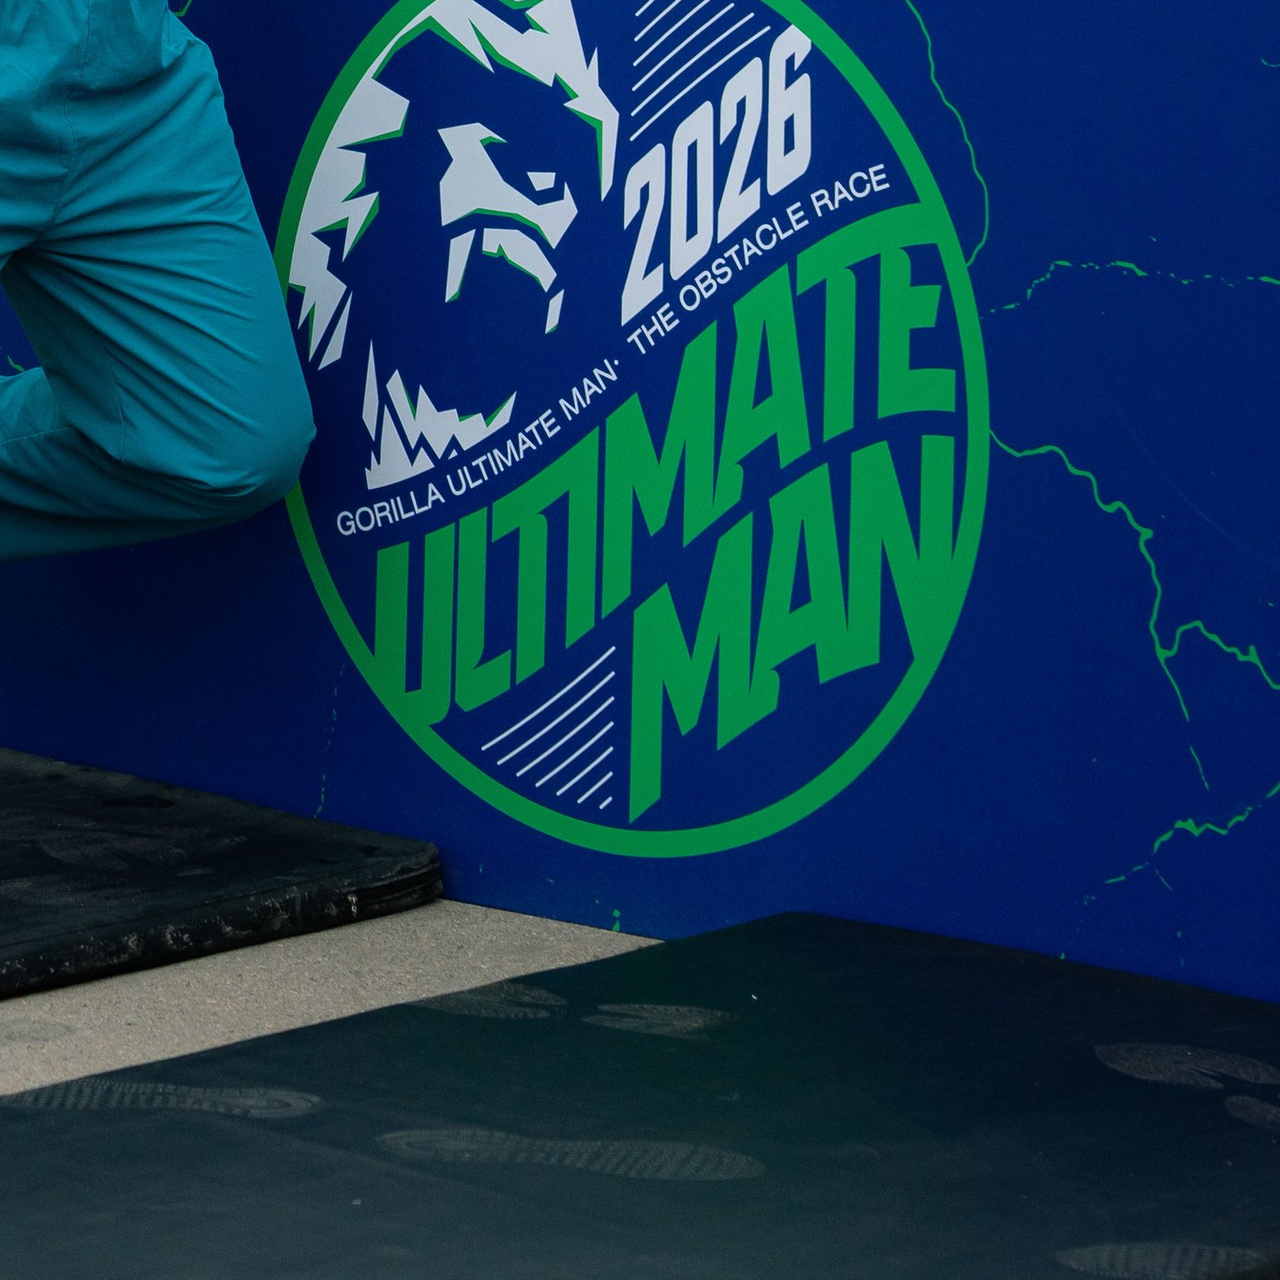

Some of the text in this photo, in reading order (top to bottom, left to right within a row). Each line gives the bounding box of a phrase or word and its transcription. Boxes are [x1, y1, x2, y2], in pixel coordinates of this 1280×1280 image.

[337, 484, 445, 537] GORILLA
[447, 414, 561, 497] ULTIMATE
[627, 302, 680, 355] THE
[679, 204, 809, 312] OBSTACLE
[810, 164, 890, 217] RACE
[622, 24, 812, 327] 2026
[375, 205, 958, 726] ULTIMATE
[629, 434, 958, 824] MAN
